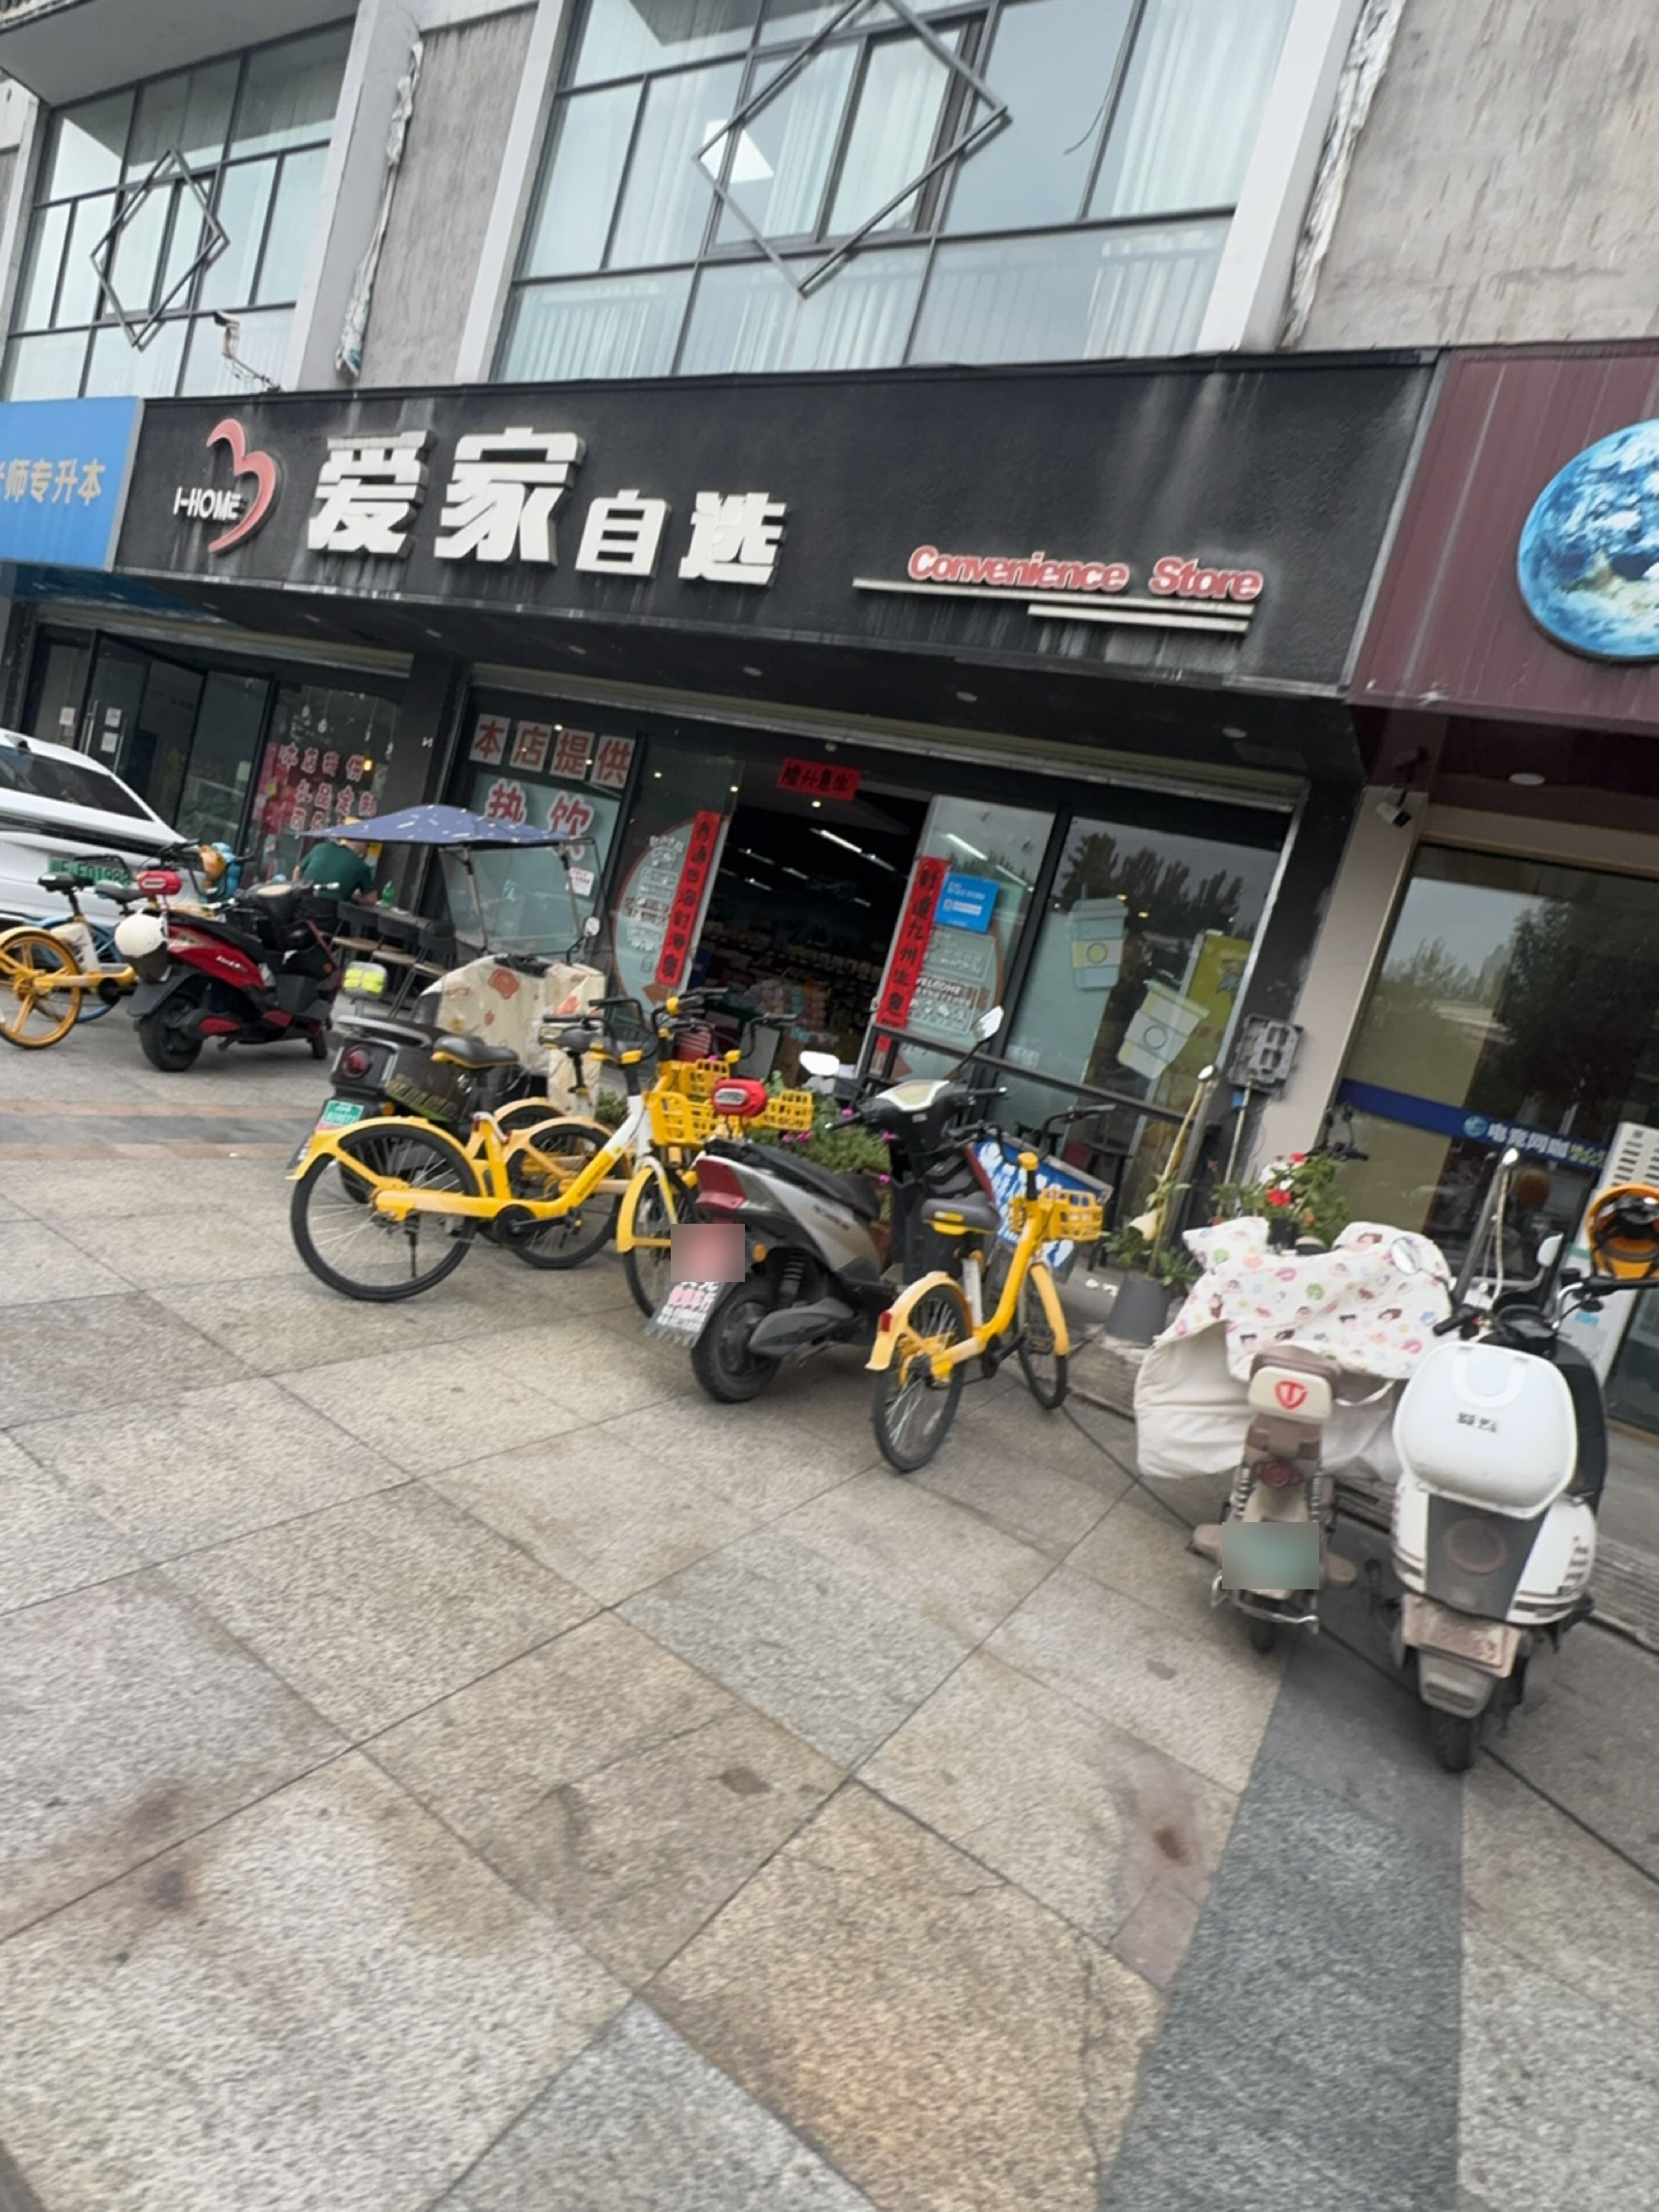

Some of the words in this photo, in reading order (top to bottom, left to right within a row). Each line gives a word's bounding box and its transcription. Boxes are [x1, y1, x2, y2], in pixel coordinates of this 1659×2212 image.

[173, 486, 244, 521] I-HOME
[307, 427, 787, 585] 爱家自选
[908, 545, 1129, 593] Convenience
[1148, 556, 1264, 602] Store
[473, 721, 633, 784] 本店提供
